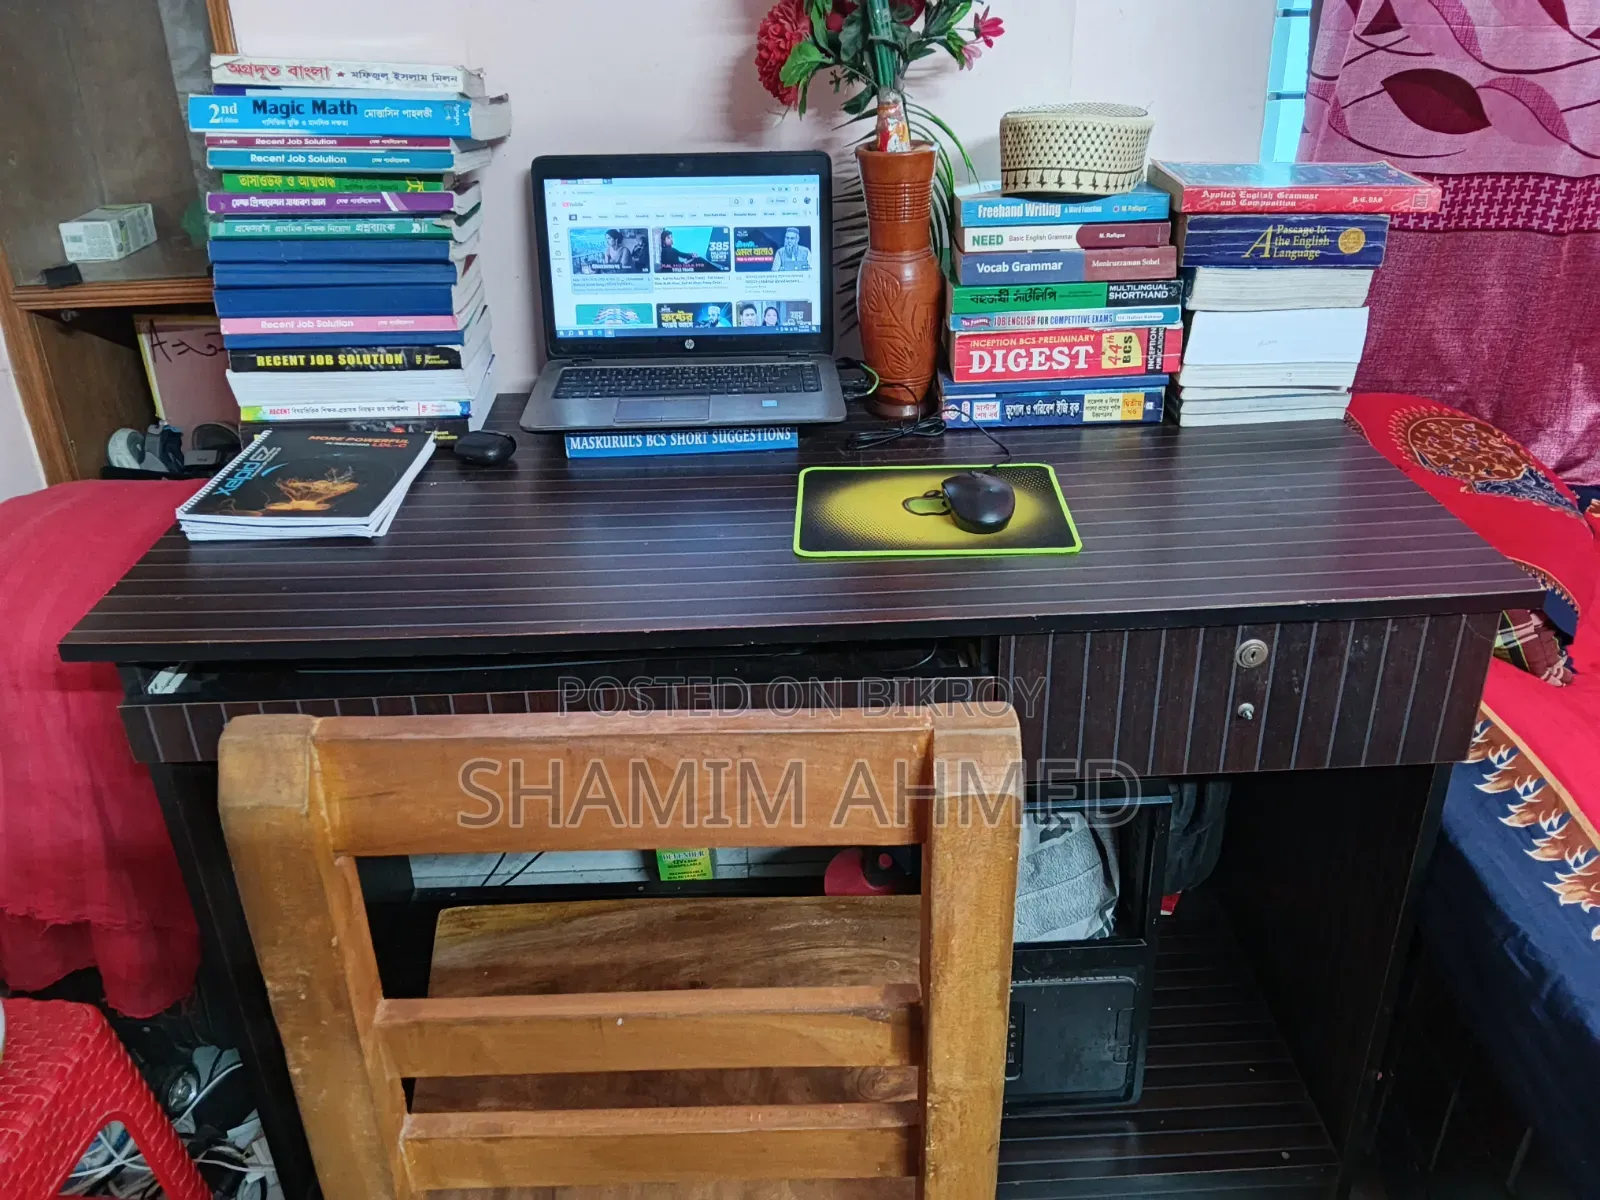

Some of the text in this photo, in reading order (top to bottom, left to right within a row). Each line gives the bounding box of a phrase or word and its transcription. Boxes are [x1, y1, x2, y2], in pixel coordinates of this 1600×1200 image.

[224, 62, 458, 82] অগ্রদূত বাংলা মফিজুল ইসলাম মিলন
[208, 103, 237, 124] 2nd
[252, 100, 358, 119] Magic Math
[250, 154, 347, 163] Recent Job Solution
[287, 176, 295, 187] ও
[1201, 190, 1319, 201] Applied English Grammar
[1239, 198, 1296, 207] Composition
[978, 203, 1024, 219] Freehand
[1025, 202, 1061, 218] Writing
[1276, 225, 1327, 236] Passage to
[709, 241, 729, 251] 385
[972, 234, 1004, 247] NEED
[1025, 233, 1047, 242] English
[1047, 233, 1073, 241] Grammar
[1240, 225, 1274, 258] A
[1274, 235, 1330, 249] the English
[1273, 247, 1320, 260] Language
[976, 261, 1009, 273] Vocab
[1012, 261, 1063, 273] Grammar
[1014, 286, 1057, 303] সাঁটলিপি
[1109, 284, 1168, 292] MULTILINGUAL
[1109, 291, 1168, 300] SHORTHAND
[261, 319, 353, 329] Recent Job Solution
[994, 316, 1006, 327] JOB
[1008, 315, 1035, 326] ENGLISH
[1037, 316, 1049, 325] FOR
[1050, 314, 1091, 325] COMPETITIVE
[1092, 314, 1113, 324] EXAMS
[971, 334, 1095, 348] INCEPTION BCS PRELIMINARY
[1106, 335, 1122, 366] 44th
[1122, 335, 1133, 364] BCS
[1148, 327, 1157, 370] INCEPTION
[257, 355, 306, 367] RECENT
[309, 354, 334, 366] JOB
[338, 353, 403, 366] SOLUTION
[969, 345, 1095, 373] DIGEST
[1005, 399, 1080, 420] ভূগোল ও পরিবেশ ইজি বুক
[1124, 398, 1142, 407] দ্বিতীয়
[570, 427, 791, 450] MASKURUL'S BCS SHORT SUGGESTIONS
